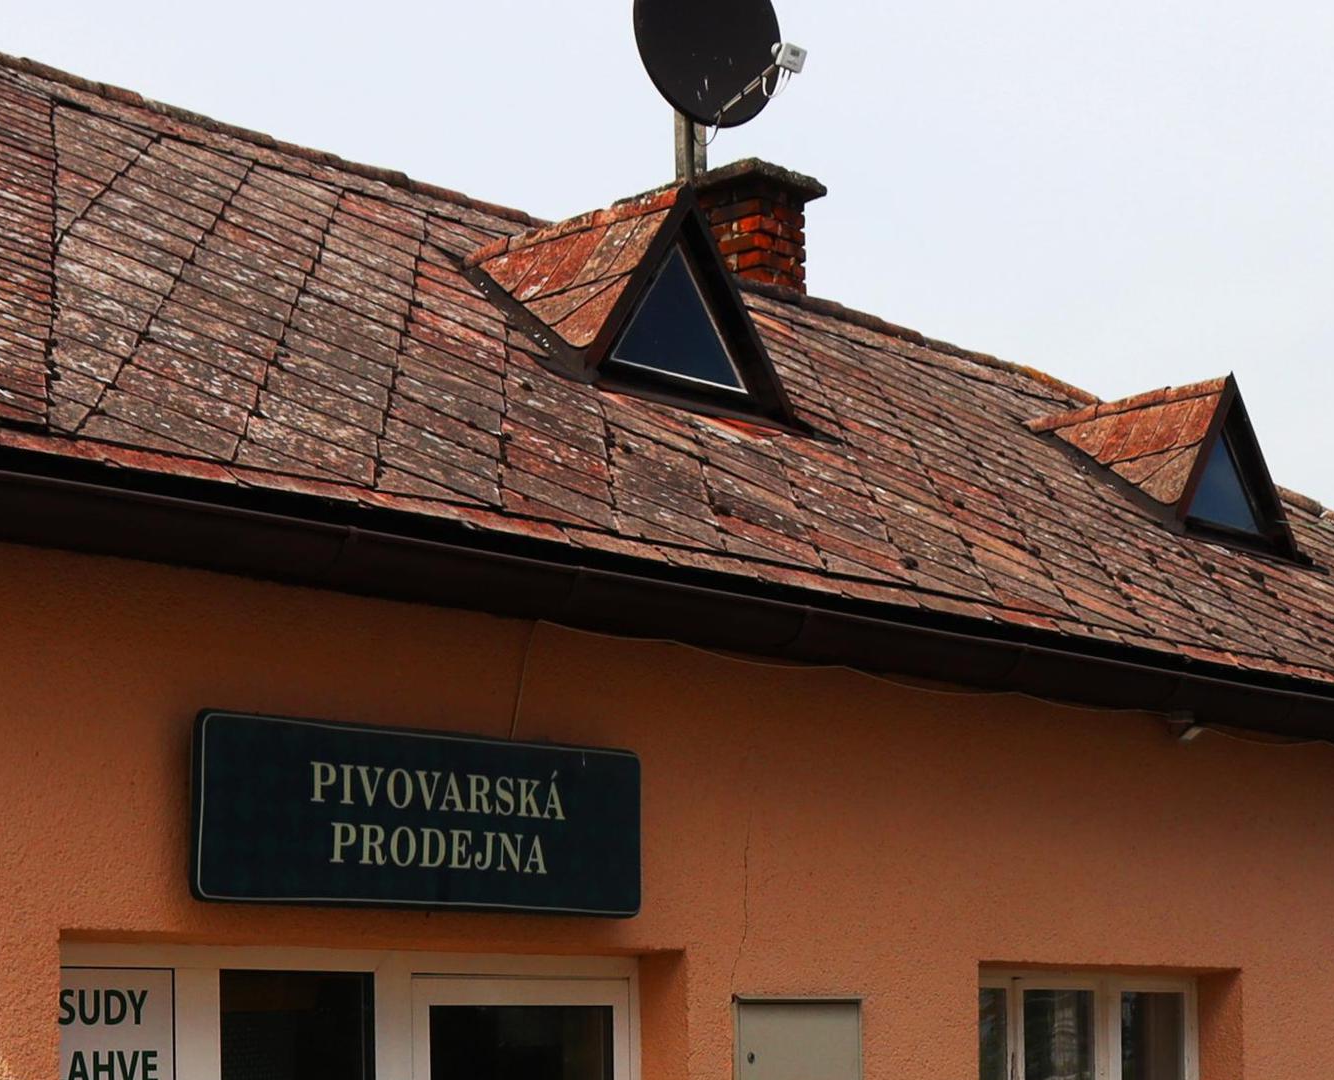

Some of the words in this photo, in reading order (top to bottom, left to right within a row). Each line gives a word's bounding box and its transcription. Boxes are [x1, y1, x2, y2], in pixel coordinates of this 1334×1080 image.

[310, 761, 566, 821] PIVOVARSKÁ
[329, 822, 547, 875] PRODEJNA
[58, 989, 148, 1025] SUDY
